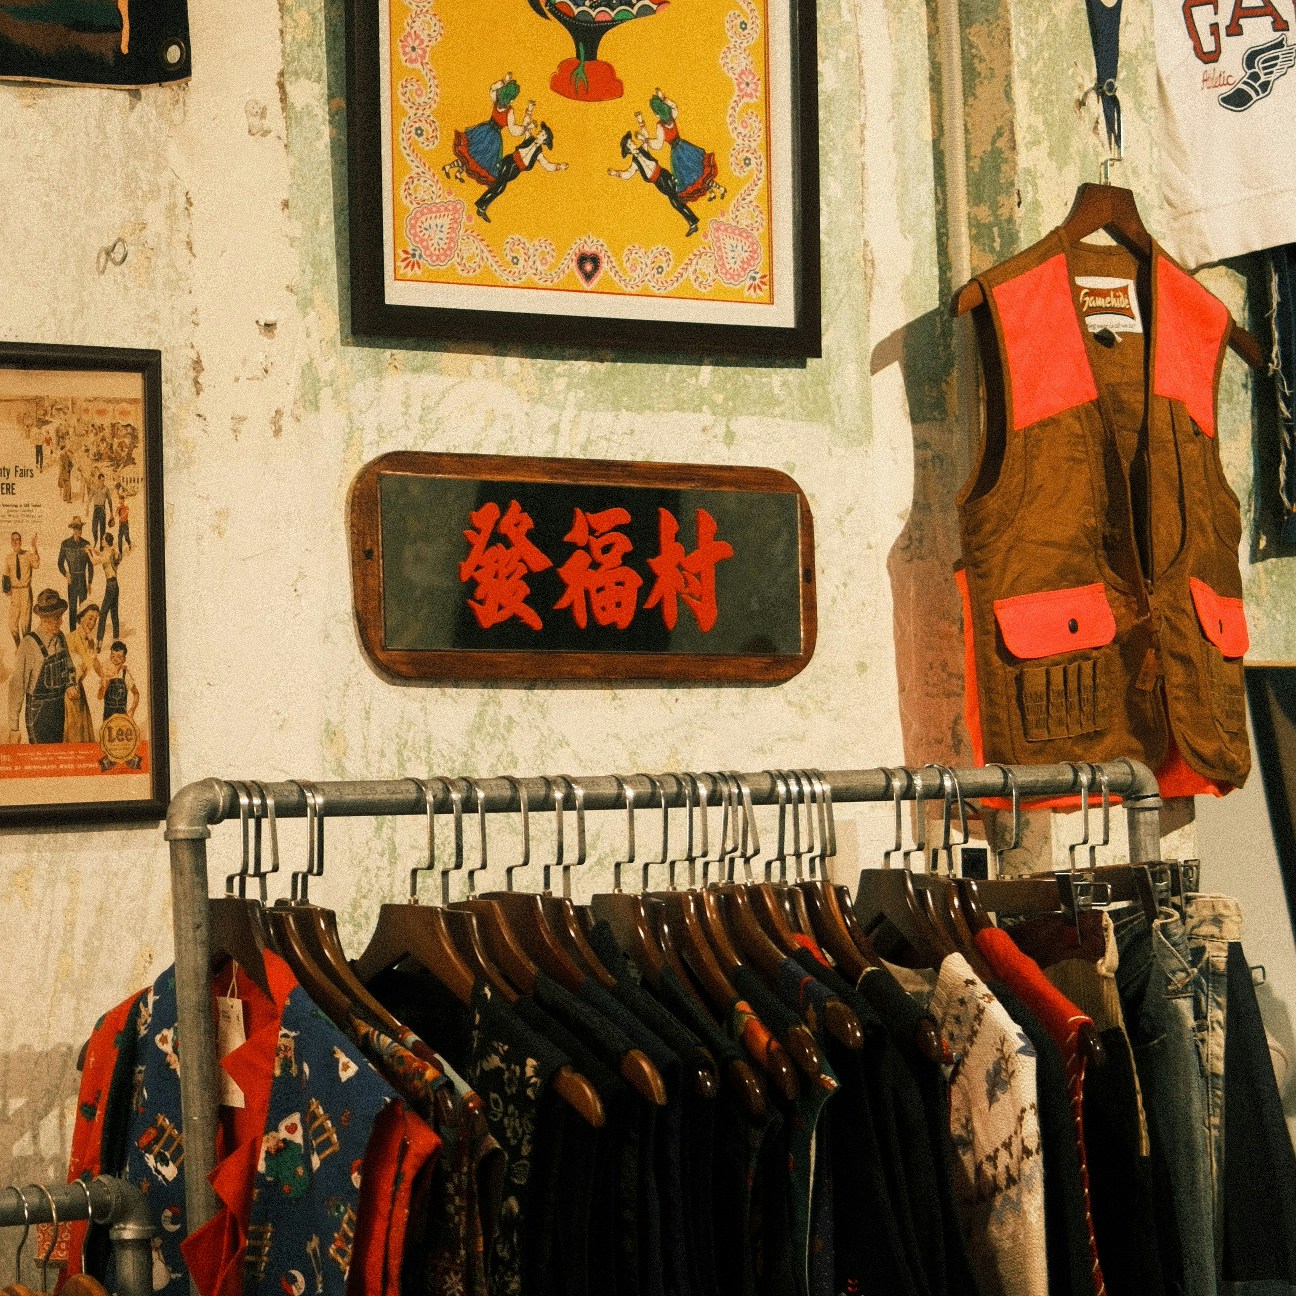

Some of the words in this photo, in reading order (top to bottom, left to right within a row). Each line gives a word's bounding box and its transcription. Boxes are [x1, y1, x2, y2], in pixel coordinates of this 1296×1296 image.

[14, 466, 34, 478] Fairs
[458, 499, 734, 633] 發福村
[107, 726, 133, 743] Lee
